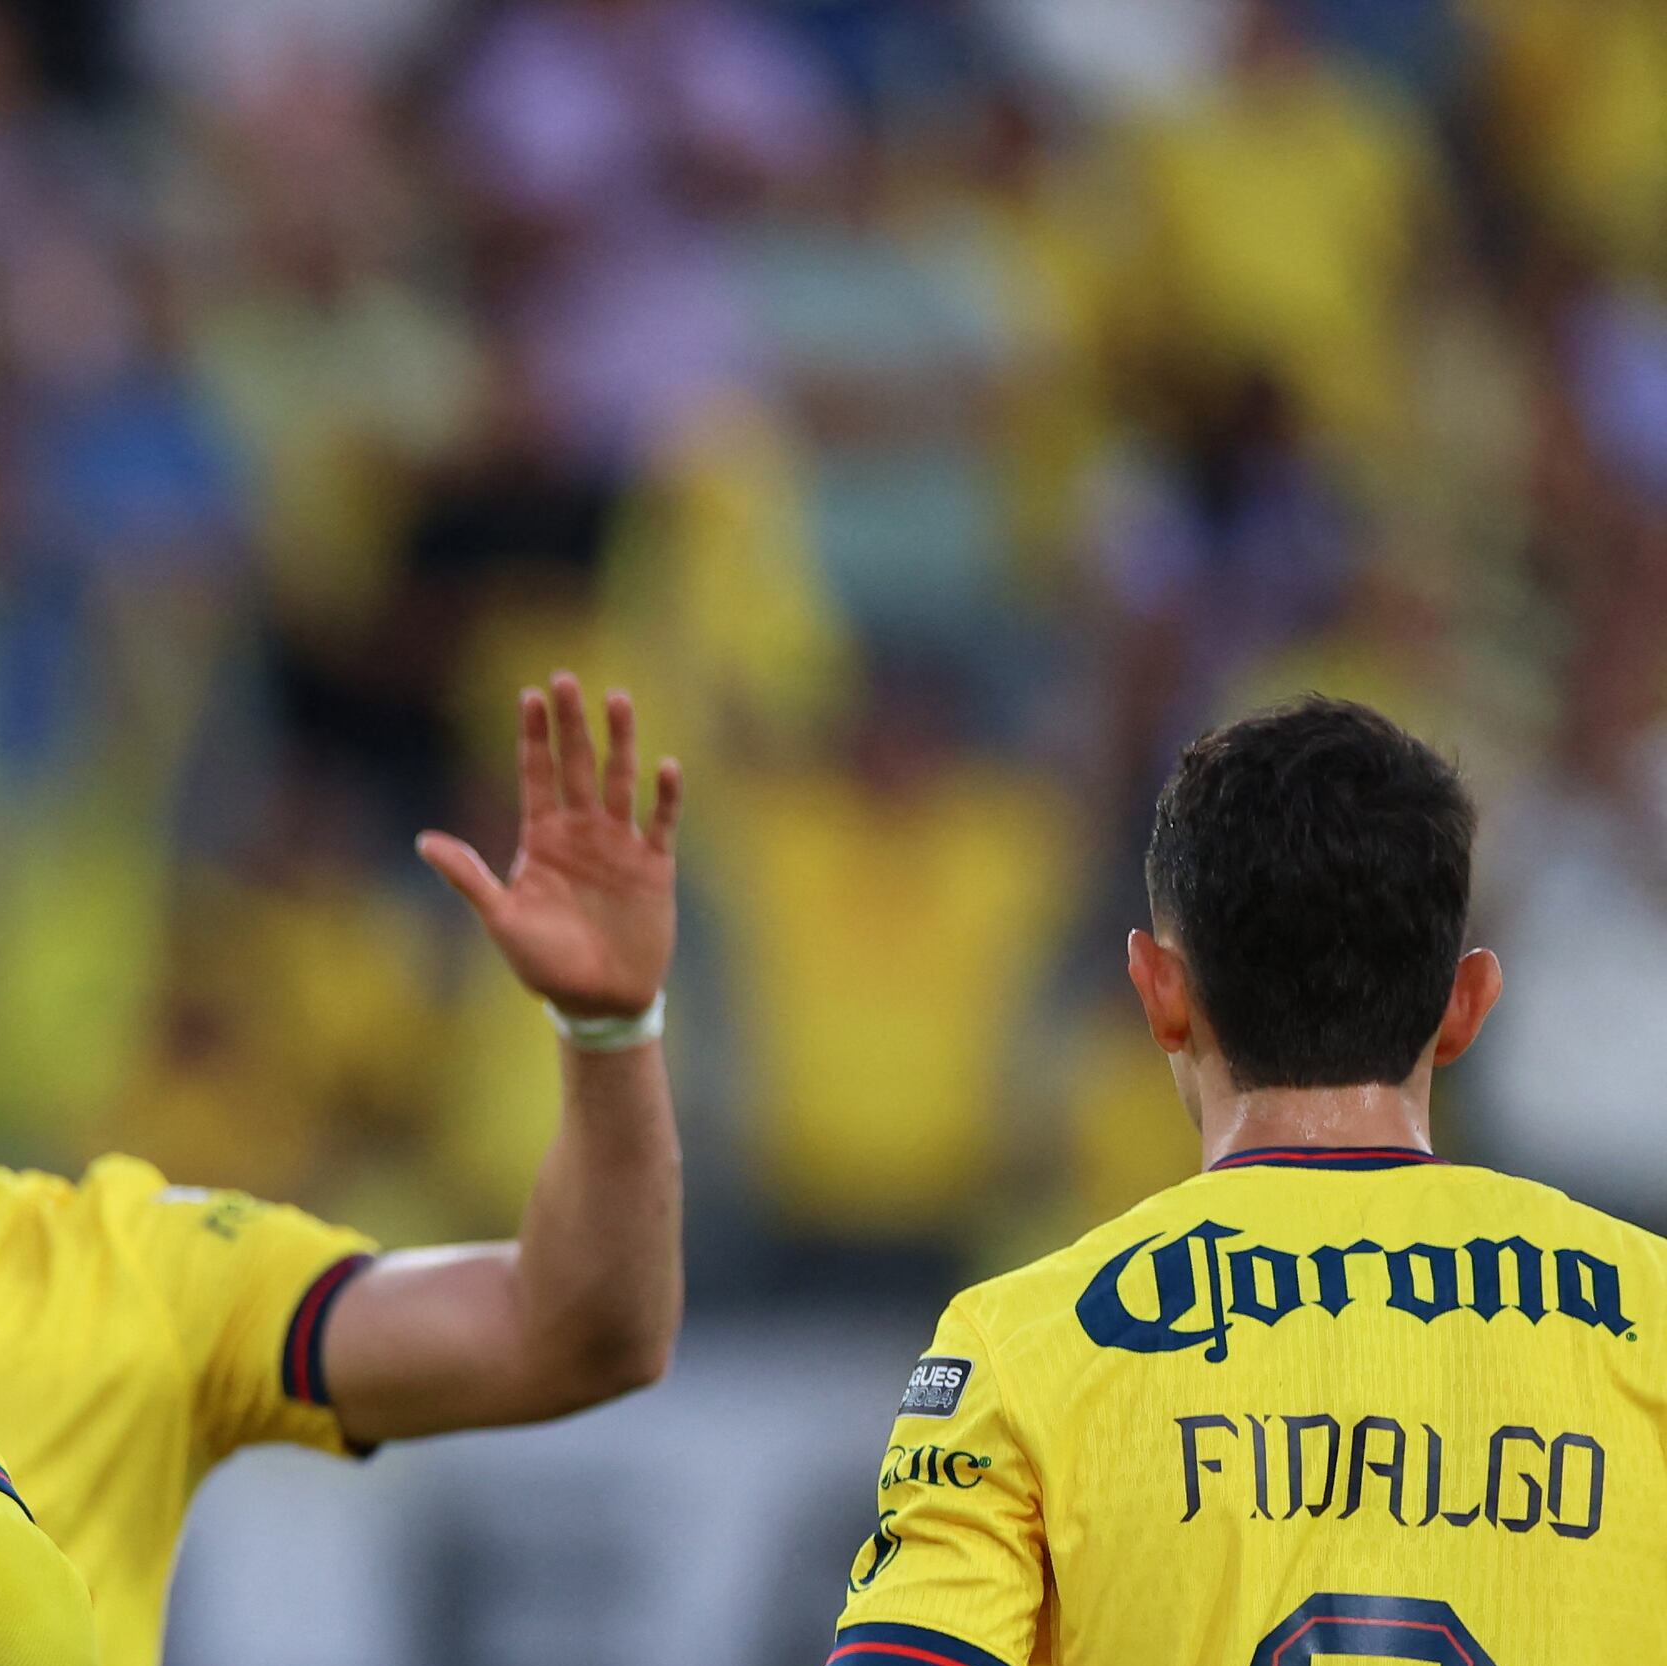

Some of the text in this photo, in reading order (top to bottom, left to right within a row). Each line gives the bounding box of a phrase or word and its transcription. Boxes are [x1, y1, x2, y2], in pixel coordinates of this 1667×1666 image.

[1075, 1219, 1633, 1362] Corona
[909, 1366, 963, 1388] GUES
[1174, 1413, 1605, 1540] FIDALGO
